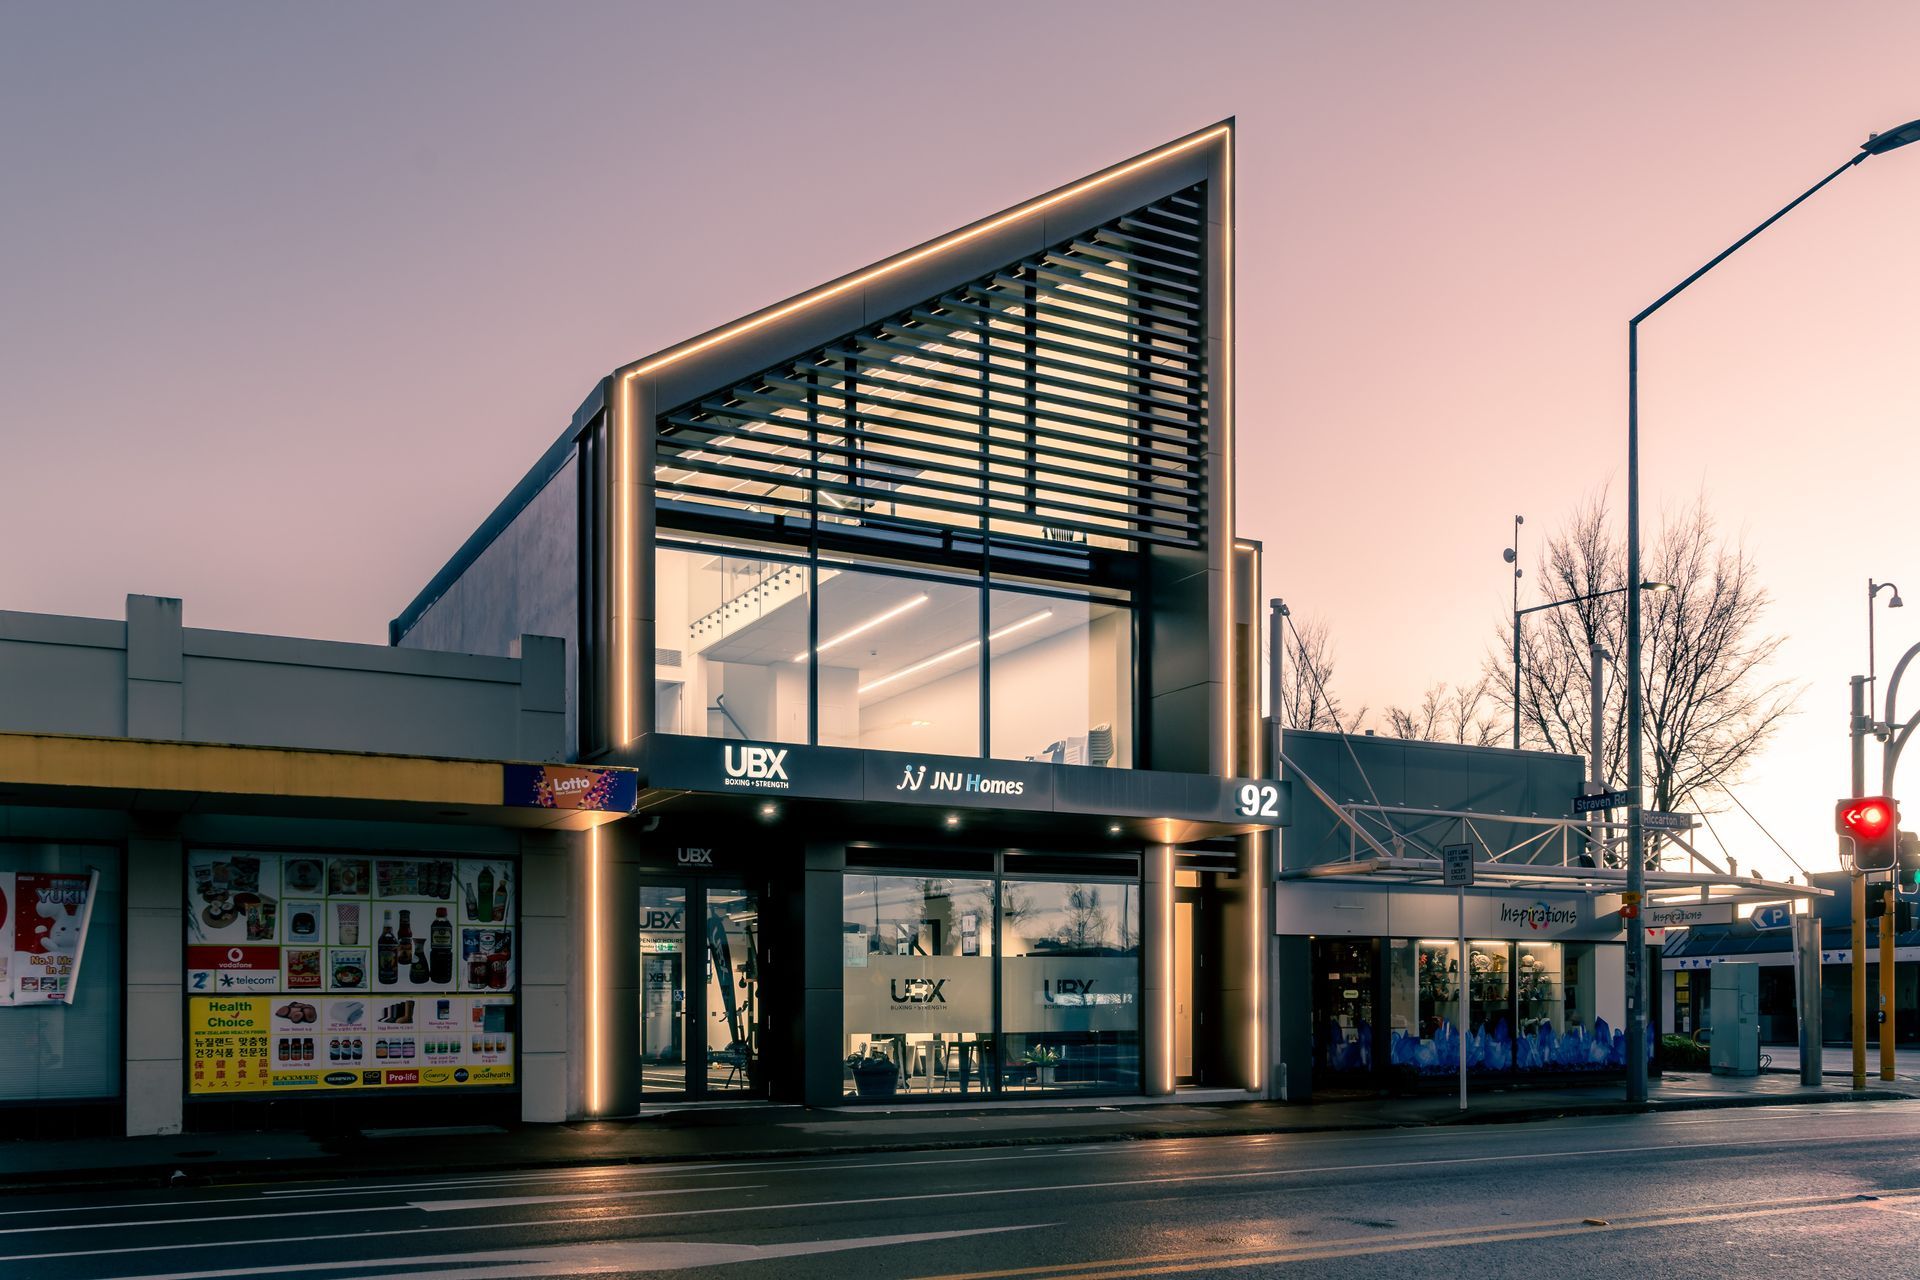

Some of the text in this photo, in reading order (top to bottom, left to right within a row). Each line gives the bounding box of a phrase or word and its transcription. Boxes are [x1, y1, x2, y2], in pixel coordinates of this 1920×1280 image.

[725, 745, 789, 780] UBX
[553, 777, 590, 792] Lotto
[725, 778, 751, 787] BOXING
[755, 780, 789, 789] STRENGTH
[930, 771, 1024, 795] JNJ Homes
[1241, 784, 1278, 817] 92
[1576, 793, 1626, 810] Straven Rd
[1643, 814, 1689, 826] Riccarton Rd
[677, 847, 713, 863] UBX
[1500, 903, 1577, 928] Inspirations
[1652, 911, 1702, 924] Inspirations
[1772, 909, 1784, 924] P
[236, 976, 274, 985] telecom
[891, 978, 947, 1003] UBX
[209, 1001, 252, 1012] Health
[207, 1017, 254, 1028] Choice
[195, 1037, 268, 1047] 뉴질랜드 맞춤형
[195, 1048, 268, 1058] 건강식품 전문점
[389, 1073, 417, 1081] Pro-life
